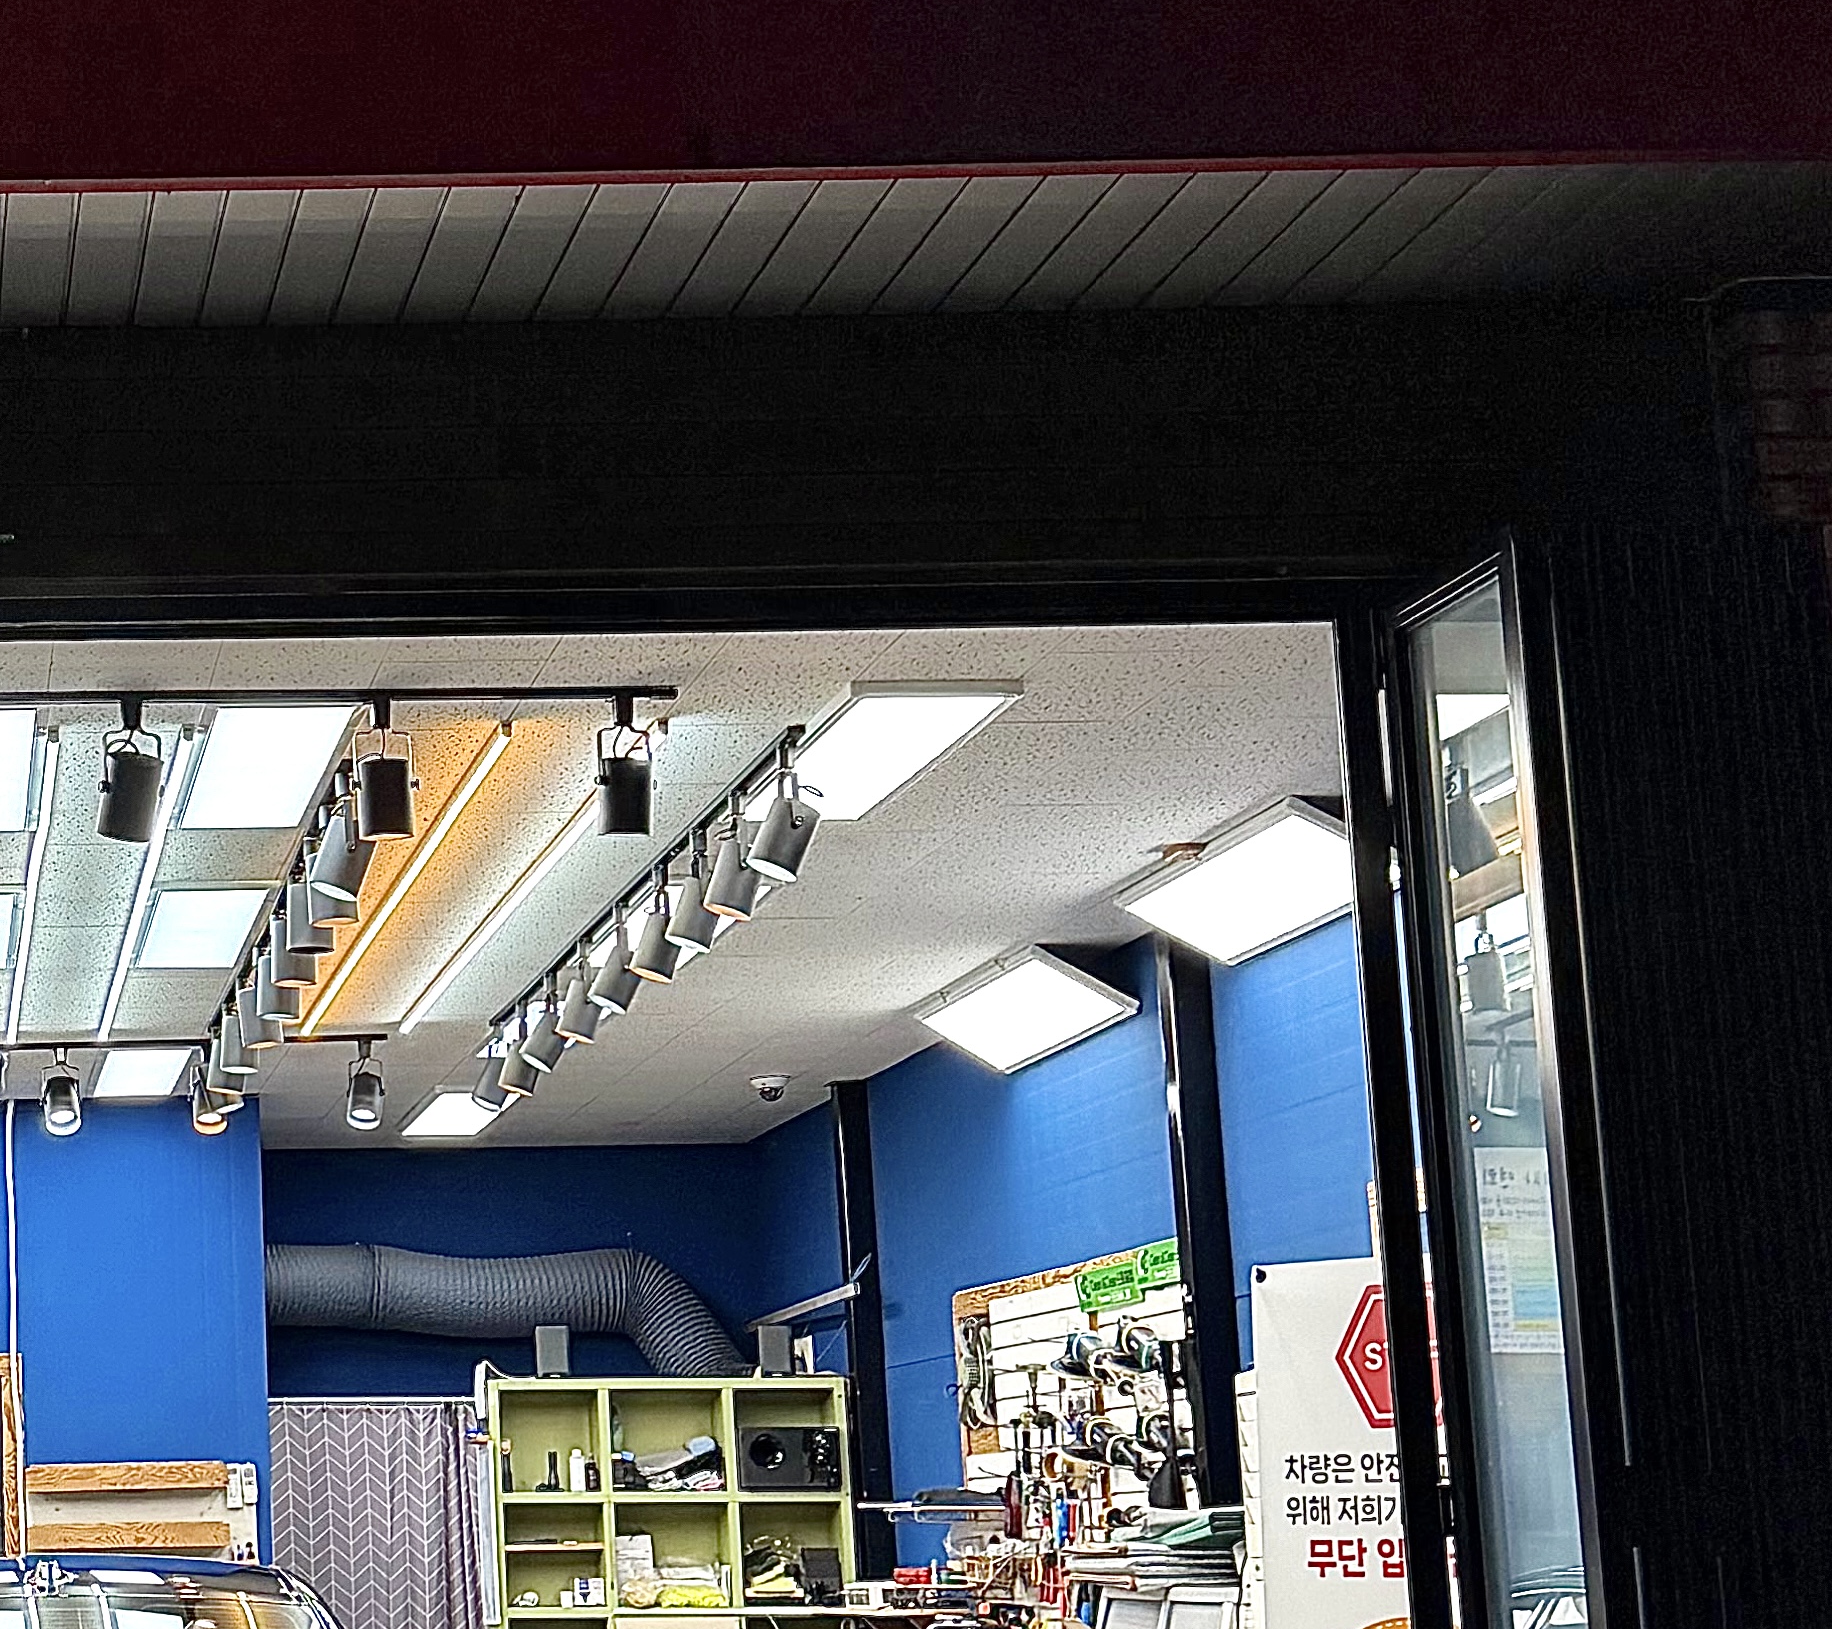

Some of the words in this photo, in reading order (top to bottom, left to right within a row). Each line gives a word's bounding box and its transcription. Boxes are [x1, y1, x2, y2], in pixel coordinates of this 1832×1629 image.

[1284, 1453, 1355, 1484] 차량은
[1286, 1496, 1331, 1526] 위해
[1308, 1538, 1368, 1578] 무단
